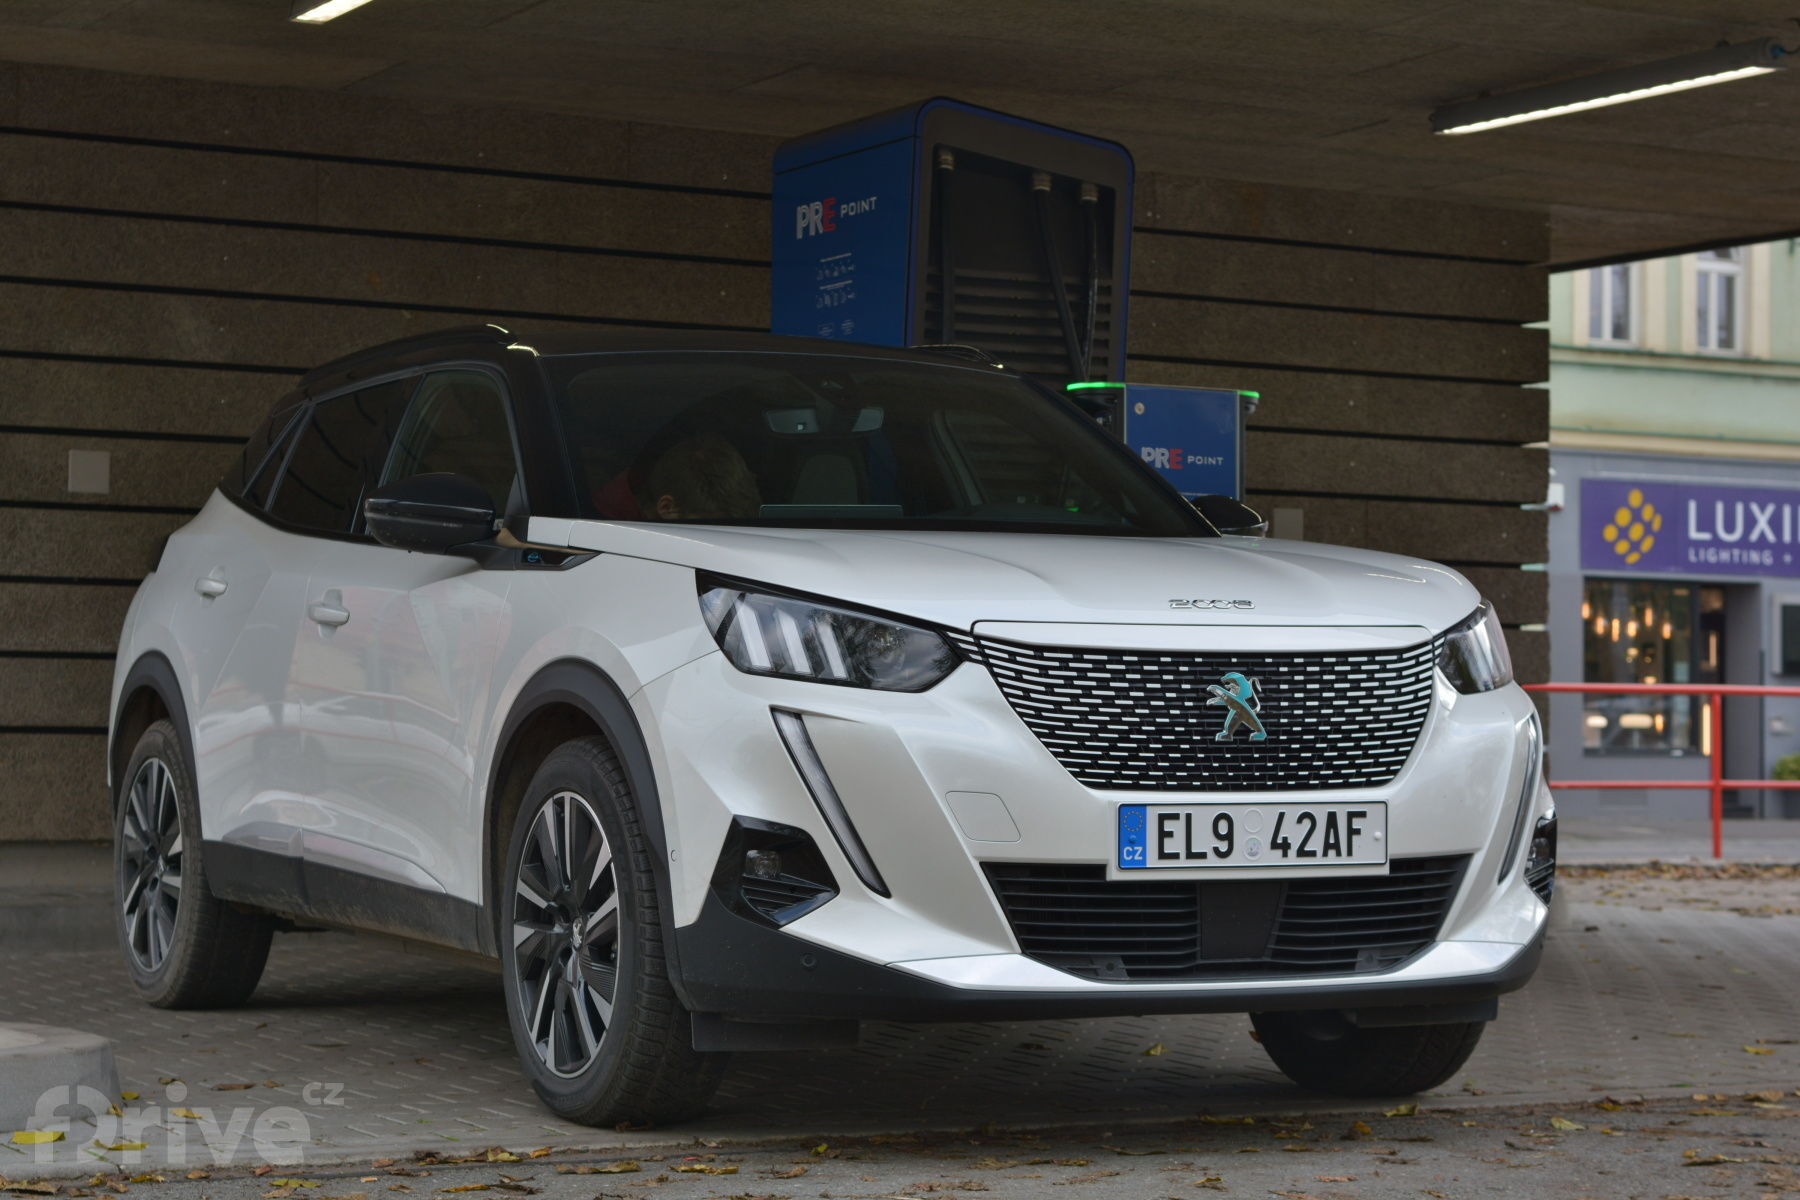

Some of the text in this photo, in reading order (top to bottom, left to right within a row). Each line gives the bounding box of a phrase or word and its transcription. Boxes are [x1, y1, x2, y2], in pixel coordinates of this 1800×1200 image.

[796, 196, 878, 240] PRE POINT
[1141, 446, 1224, 470] PRE POINT
[1688, 498, 1800, 545] LUXI
[1688, 546, 1775, 567] LIGHTING
[1168, 599, 1256, 610] 2008
[1157, 809, 1367, 860] EL9 42AF
[1123, 846, 1143, 861] CZ
